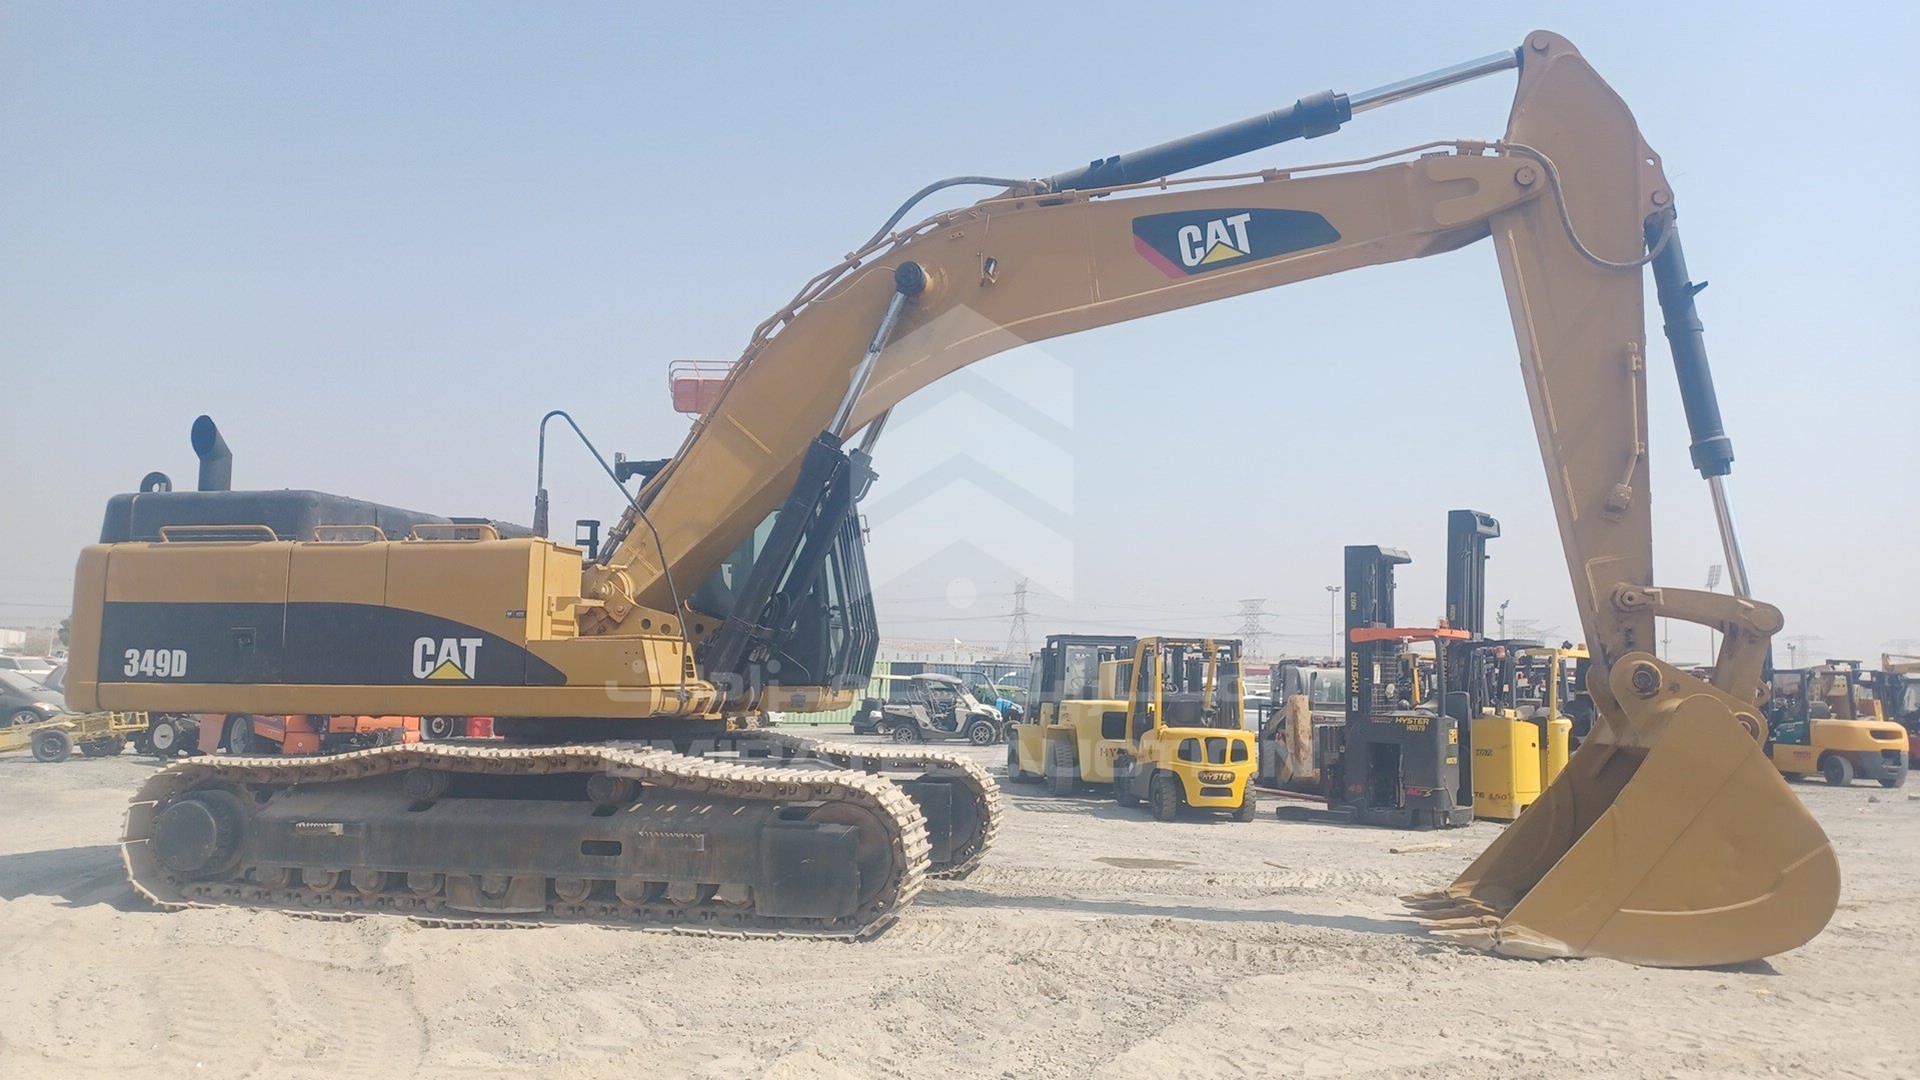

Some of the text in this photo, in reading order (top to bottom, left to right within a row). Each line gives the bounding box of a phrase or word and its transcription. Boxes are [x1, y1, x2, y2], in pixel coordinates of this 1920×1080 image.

[1178, 212, 1251, 267] CAT
[124, 649, 187, 677] 349D
[413, 637, 482, 680] CAT
[1351, 652, 1359, 693] HYSTER
[1395, 717, 1430, 725] HYSTER
